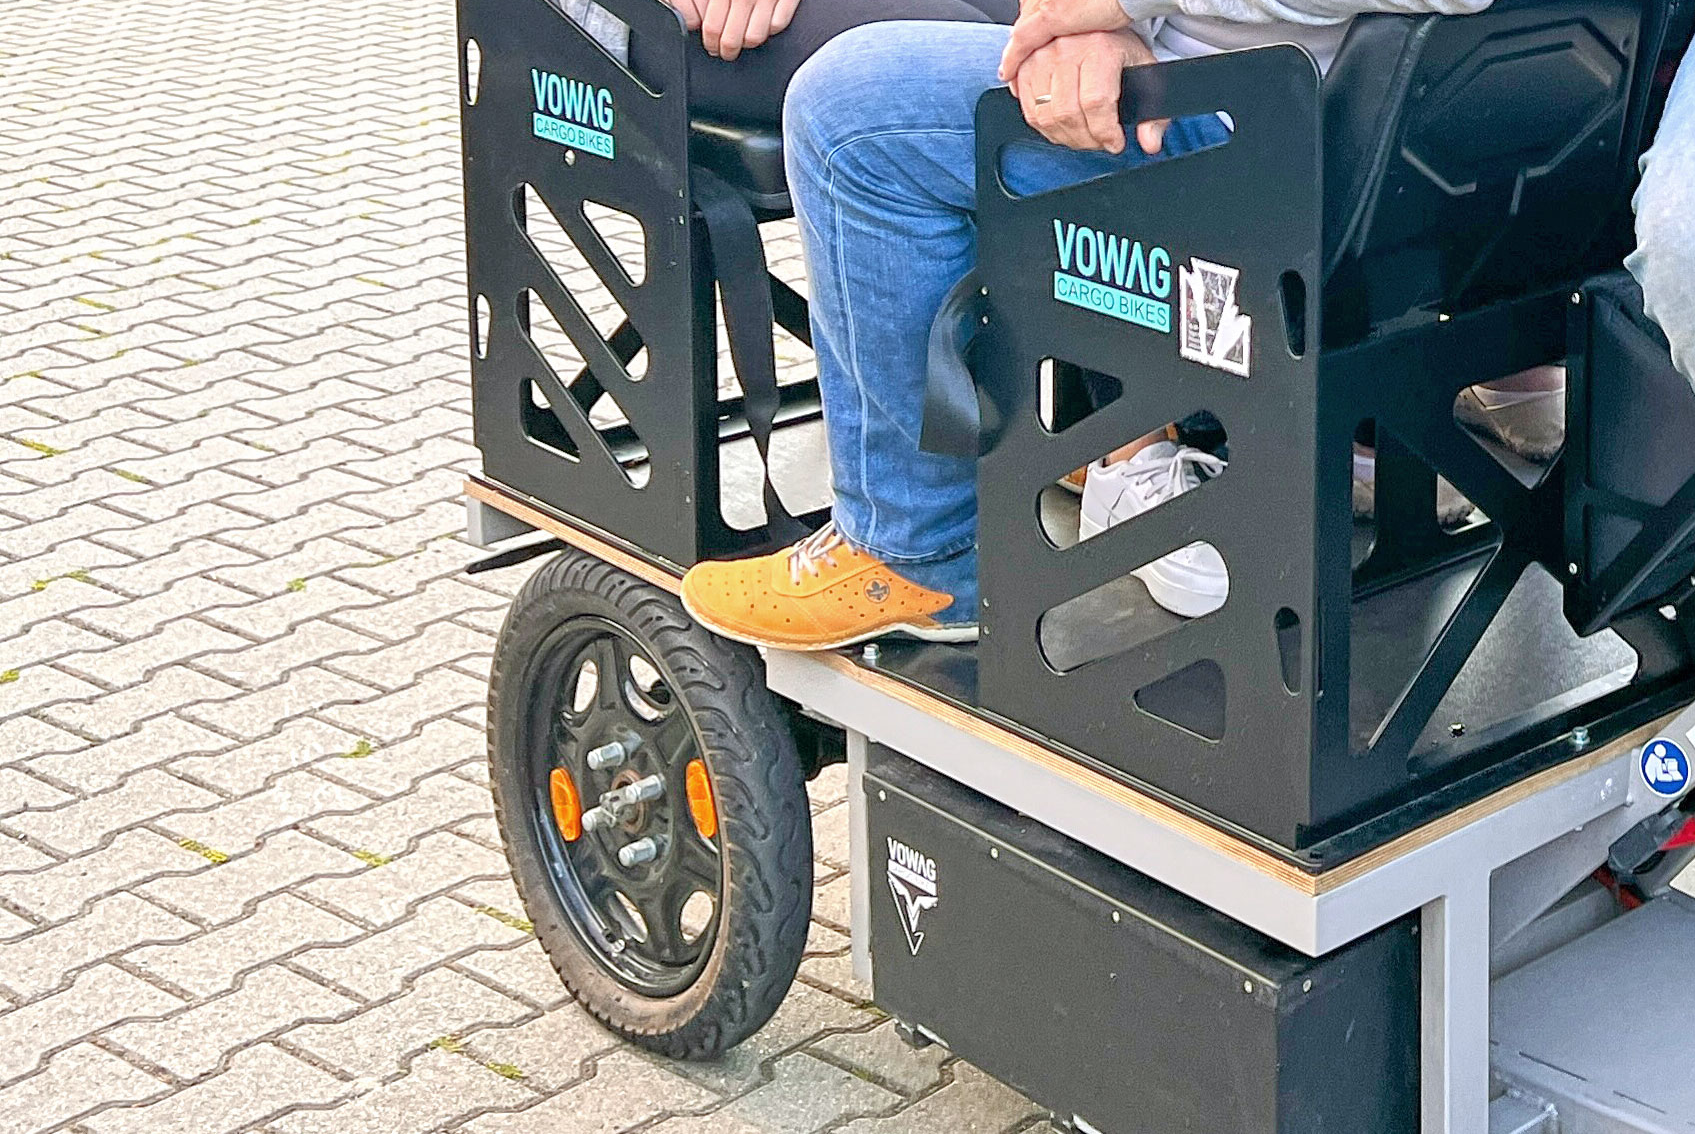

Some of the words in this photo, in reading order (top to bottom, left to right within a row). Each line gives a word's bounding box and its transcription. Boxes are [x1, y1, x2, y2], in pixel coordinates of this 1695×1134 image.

[531, 67, 615, 132] VOWAG
[535, 117, 577, 143] CARGO
[578, 129, 611, 154] BIKES
[1053, 218, 1172, 299] VOWAG
[1056, 277, 1115, 310] CARGO
[1119, 295, 1167, 327] BIKES
[886, 836, 937, 882] VOWAG
